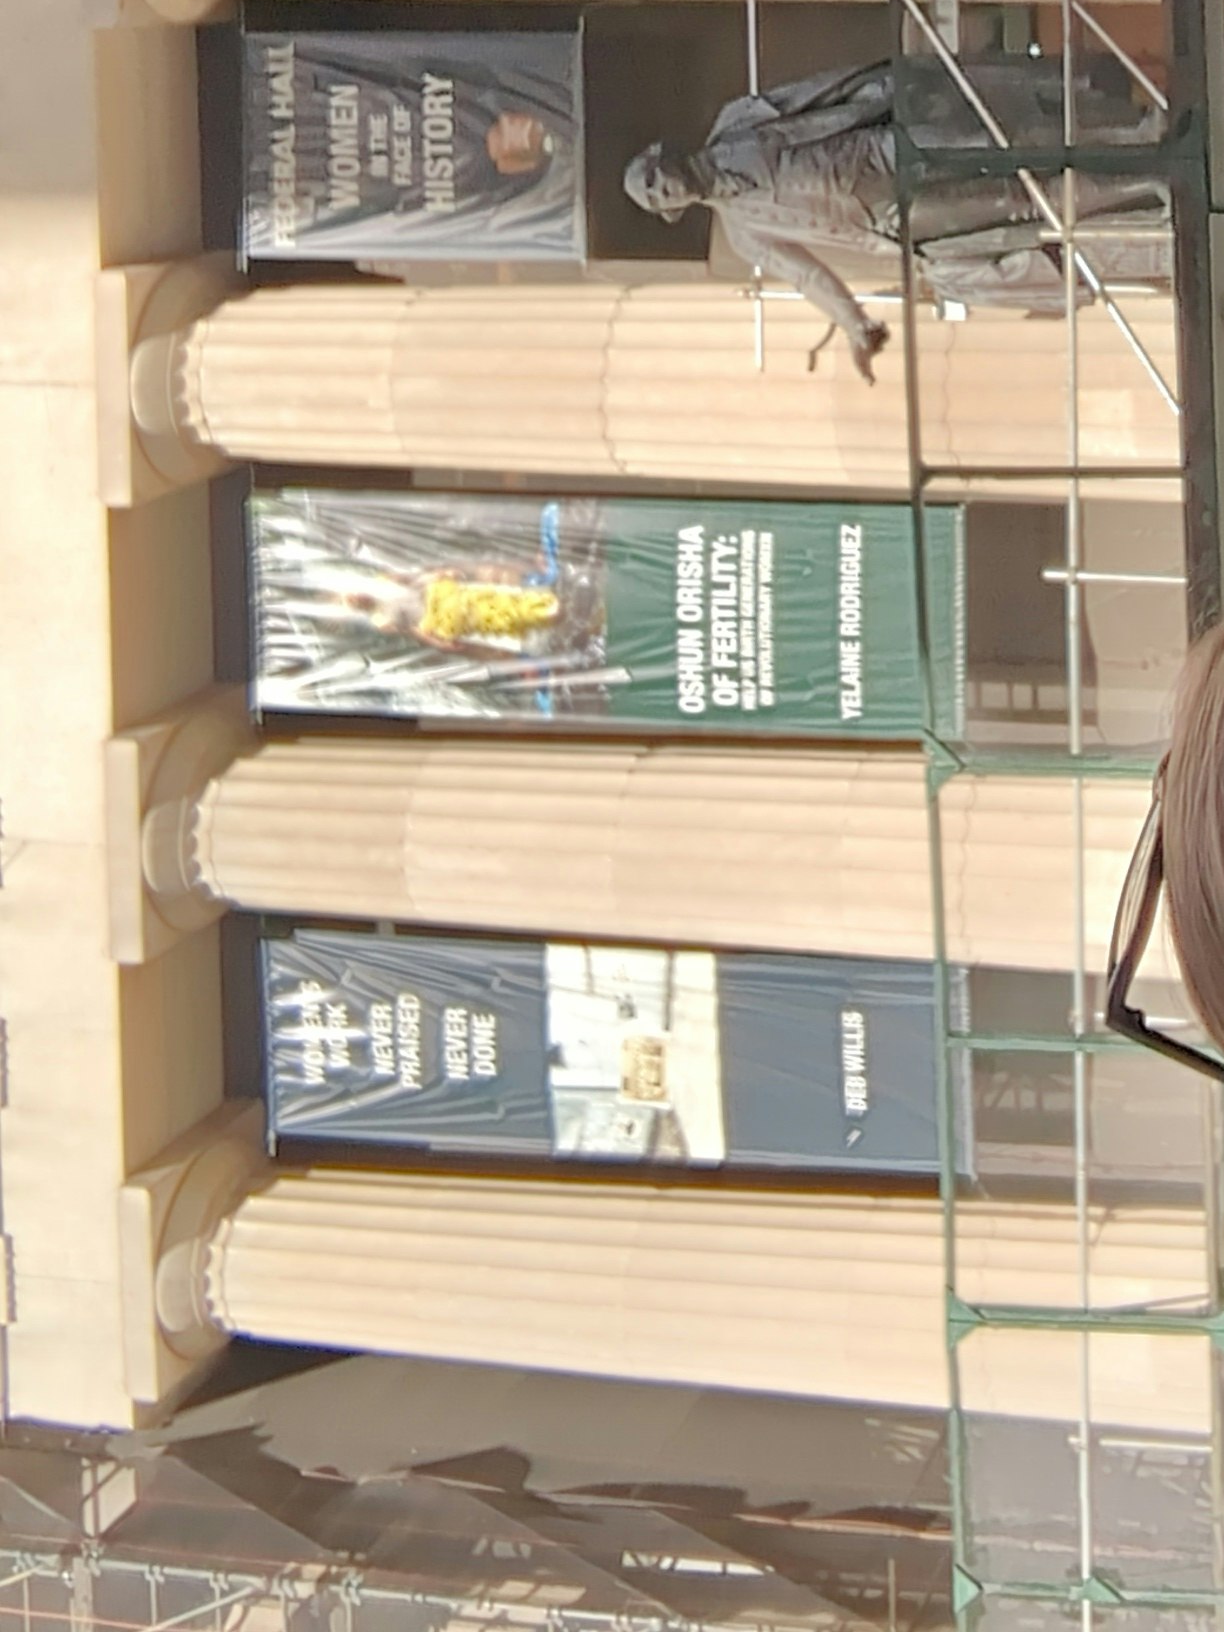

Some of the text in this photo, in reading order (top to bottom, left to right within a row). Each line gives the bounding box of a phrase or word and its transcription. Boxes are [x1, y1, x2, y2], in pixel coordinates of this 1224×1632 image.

[265, 41, 296, 248] FEDERAL HALL
[327, 84, 360, 210] WOMEN
[369, 113, 389, 177] IN THE
[392, 104, 412, 186] FACE OF
[421, 72, 455, 214] HISTORY
[676, 525, 705, 714] OSHUN ORISHA
[711, 534, 739, 706] OF FERTILITY:
[740, 530, 756, 618] GENERATIONS
[839, 524, 862, 720] YELAINE RODRIGUEZ
[758, 585, 773, 687] REVOLUTIONARY
[301, 981, 326, 1085] WOENS
[327, 1003, 350, 1069] WORK
[370, 1003, 395, 1076] NEVER
[397, 992, 423, 1089] PRAISED
[443, 1007, 470, 1080] NEVER
[472, 1012, 497, 1076] DONE
[840, 1011, 867, 1072] WILLIS
